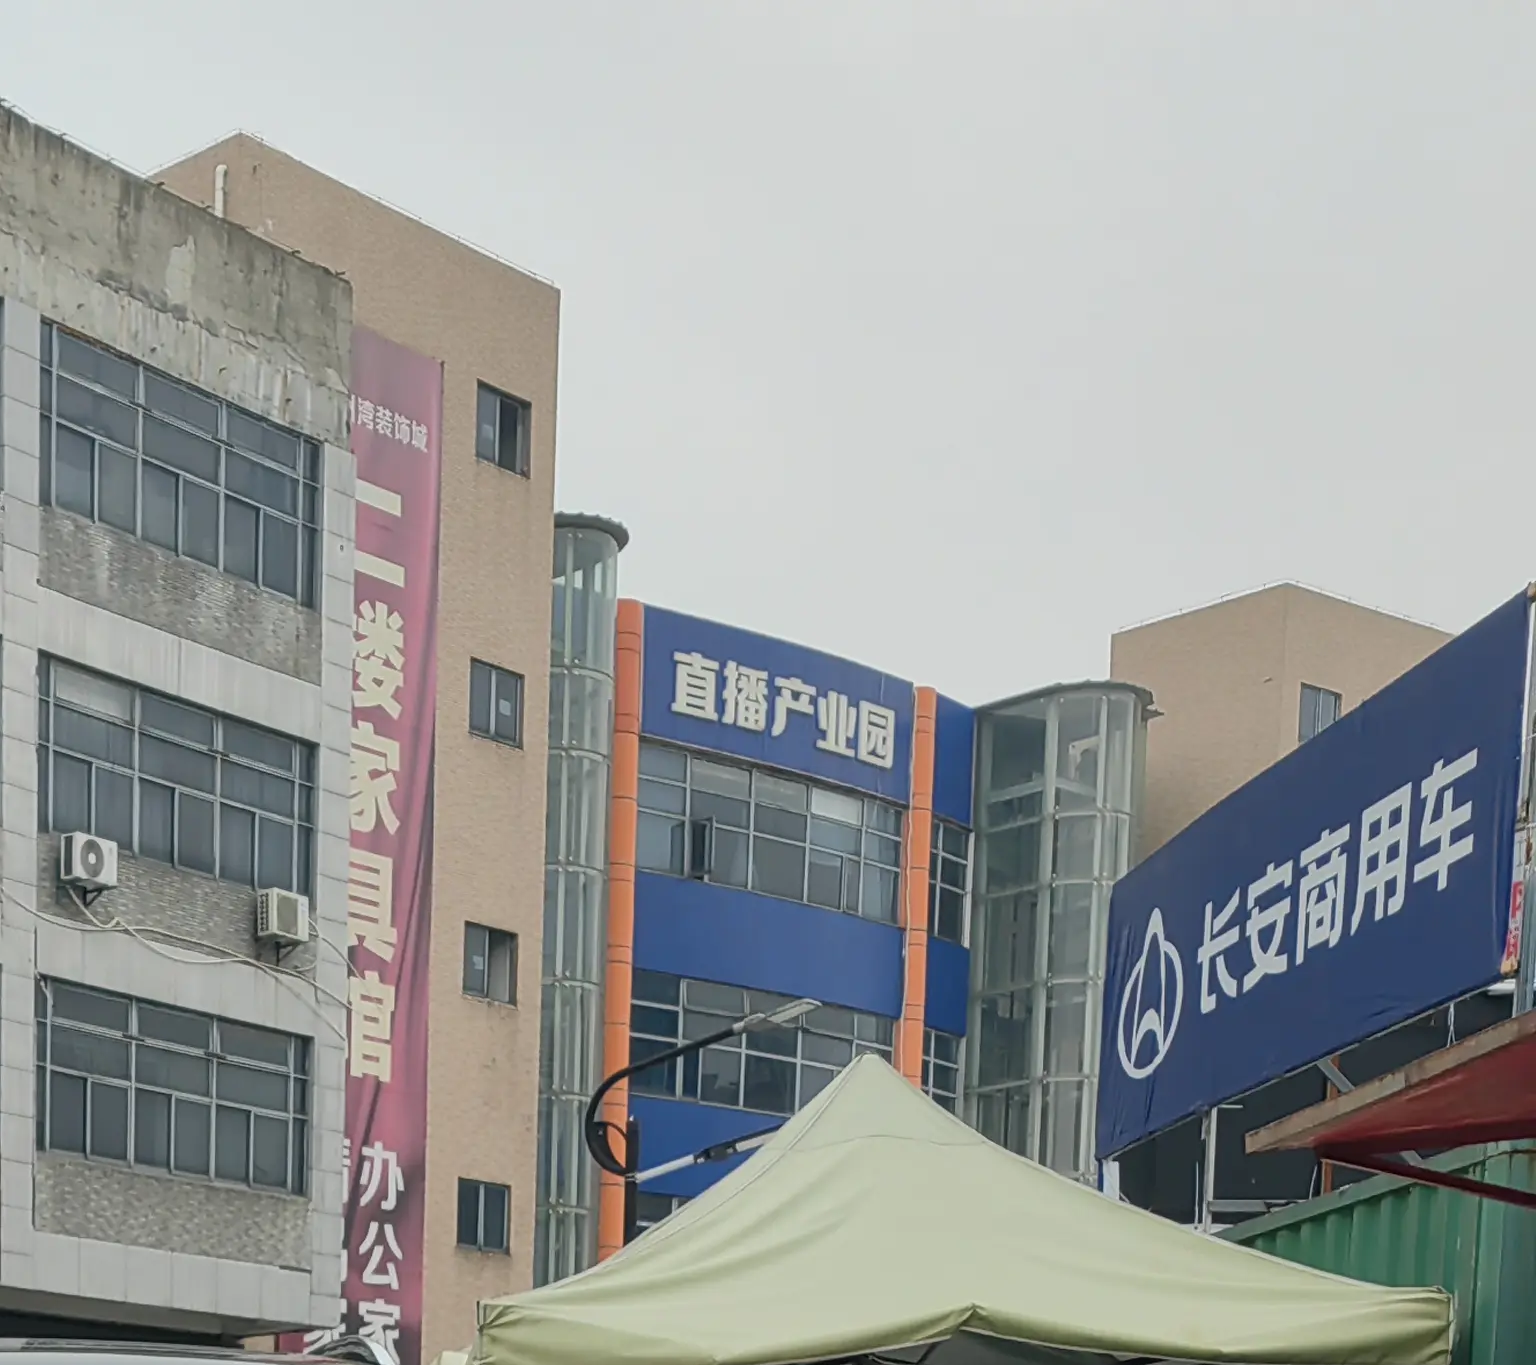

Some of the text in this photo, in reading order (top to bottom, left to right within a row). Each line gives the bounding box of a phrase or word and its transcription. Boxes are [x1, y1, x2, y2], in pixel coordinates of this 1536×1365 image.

[350, 394, 428, 453] 湾装饰城
[670, 651, 896, 769] 直播产业园
[1197, 747, 1479, 1015] 长安商用车
